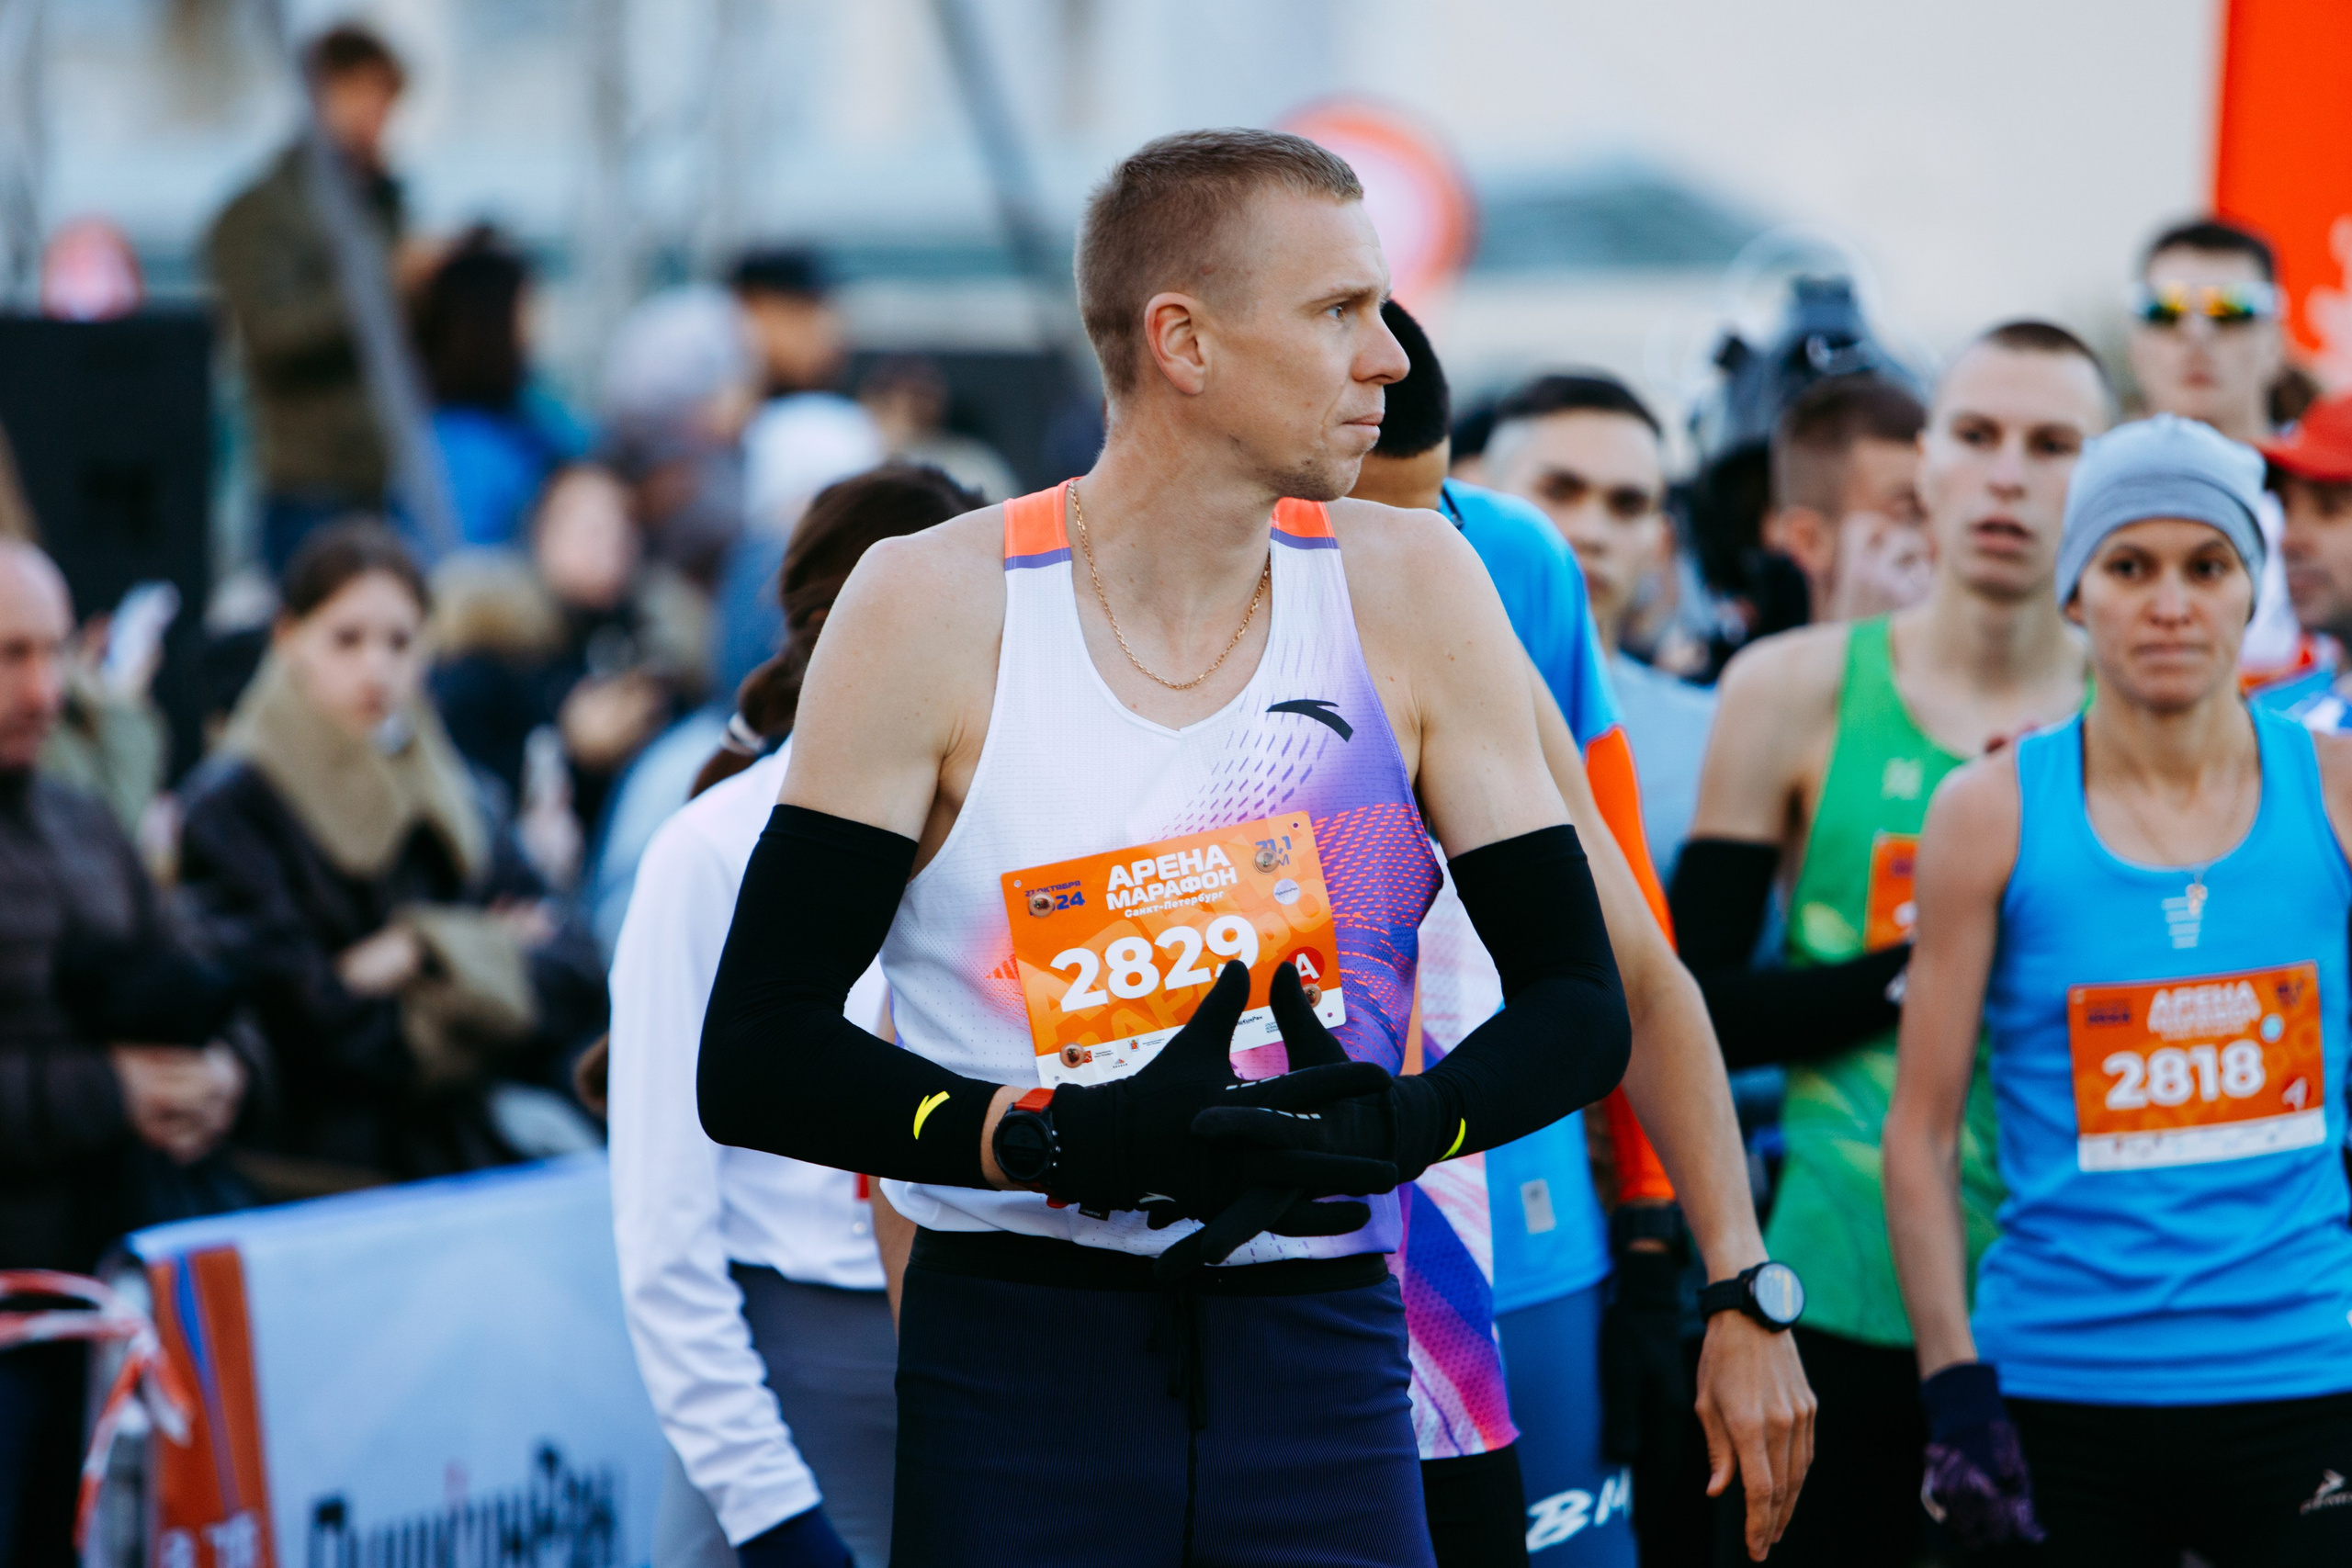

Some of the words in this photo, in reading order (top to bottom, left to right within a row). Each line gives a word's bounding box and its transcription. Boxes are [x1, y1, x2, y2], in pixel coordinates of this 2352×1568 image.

[1105, 867, 1238, 910] МАРАФОН
[1107, 844, 1231, 891] АРЕНА
[1125, 891, 1225, 918] Санкт-Петербург
[1050, 915, 1259, 1012] 2829
[2102, 1039, 2266, 1111] 2818
